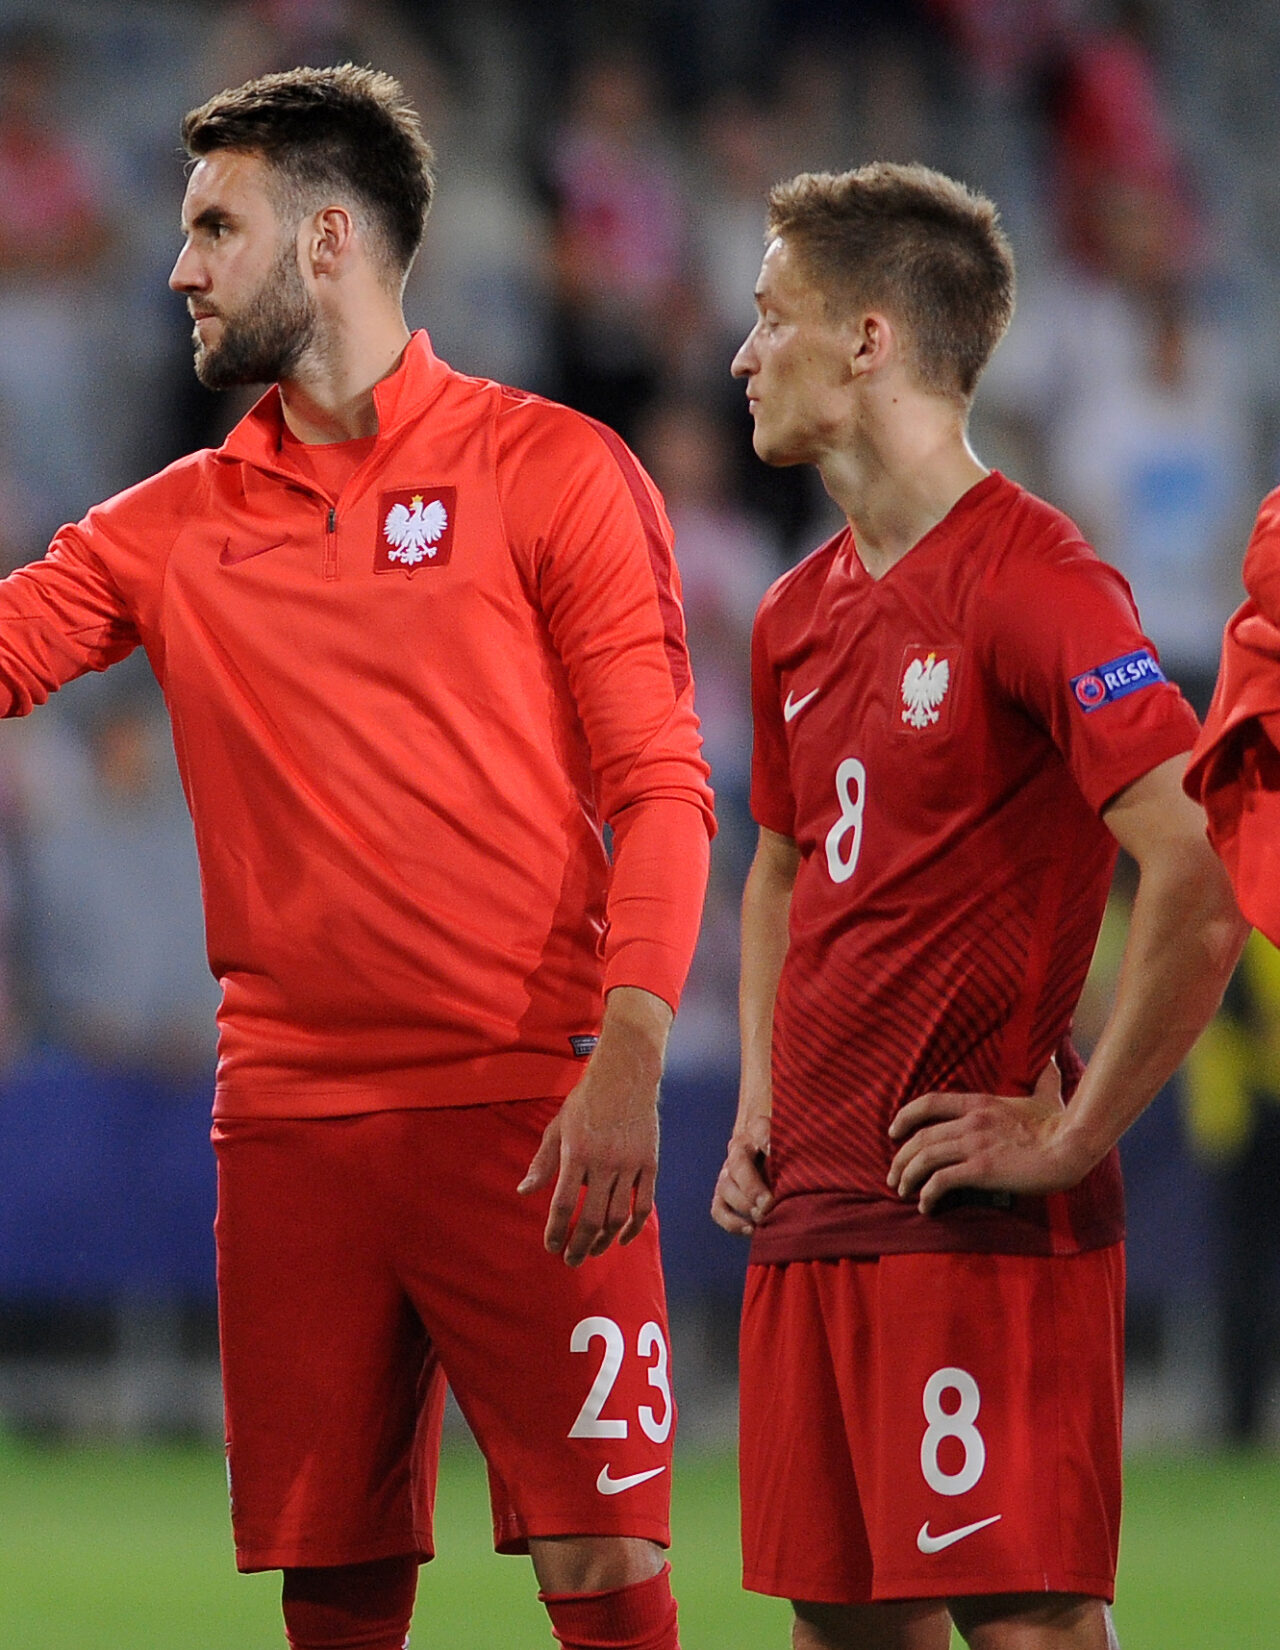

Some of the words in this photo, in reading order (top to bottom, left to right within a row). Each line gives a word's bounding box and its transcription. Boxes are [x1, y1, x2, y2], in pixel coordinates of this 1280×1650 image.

[825, 757, 866, 884] 8
[567, 1315, 672, 1444] 23
[920, 1366, 986, 1496] 8
